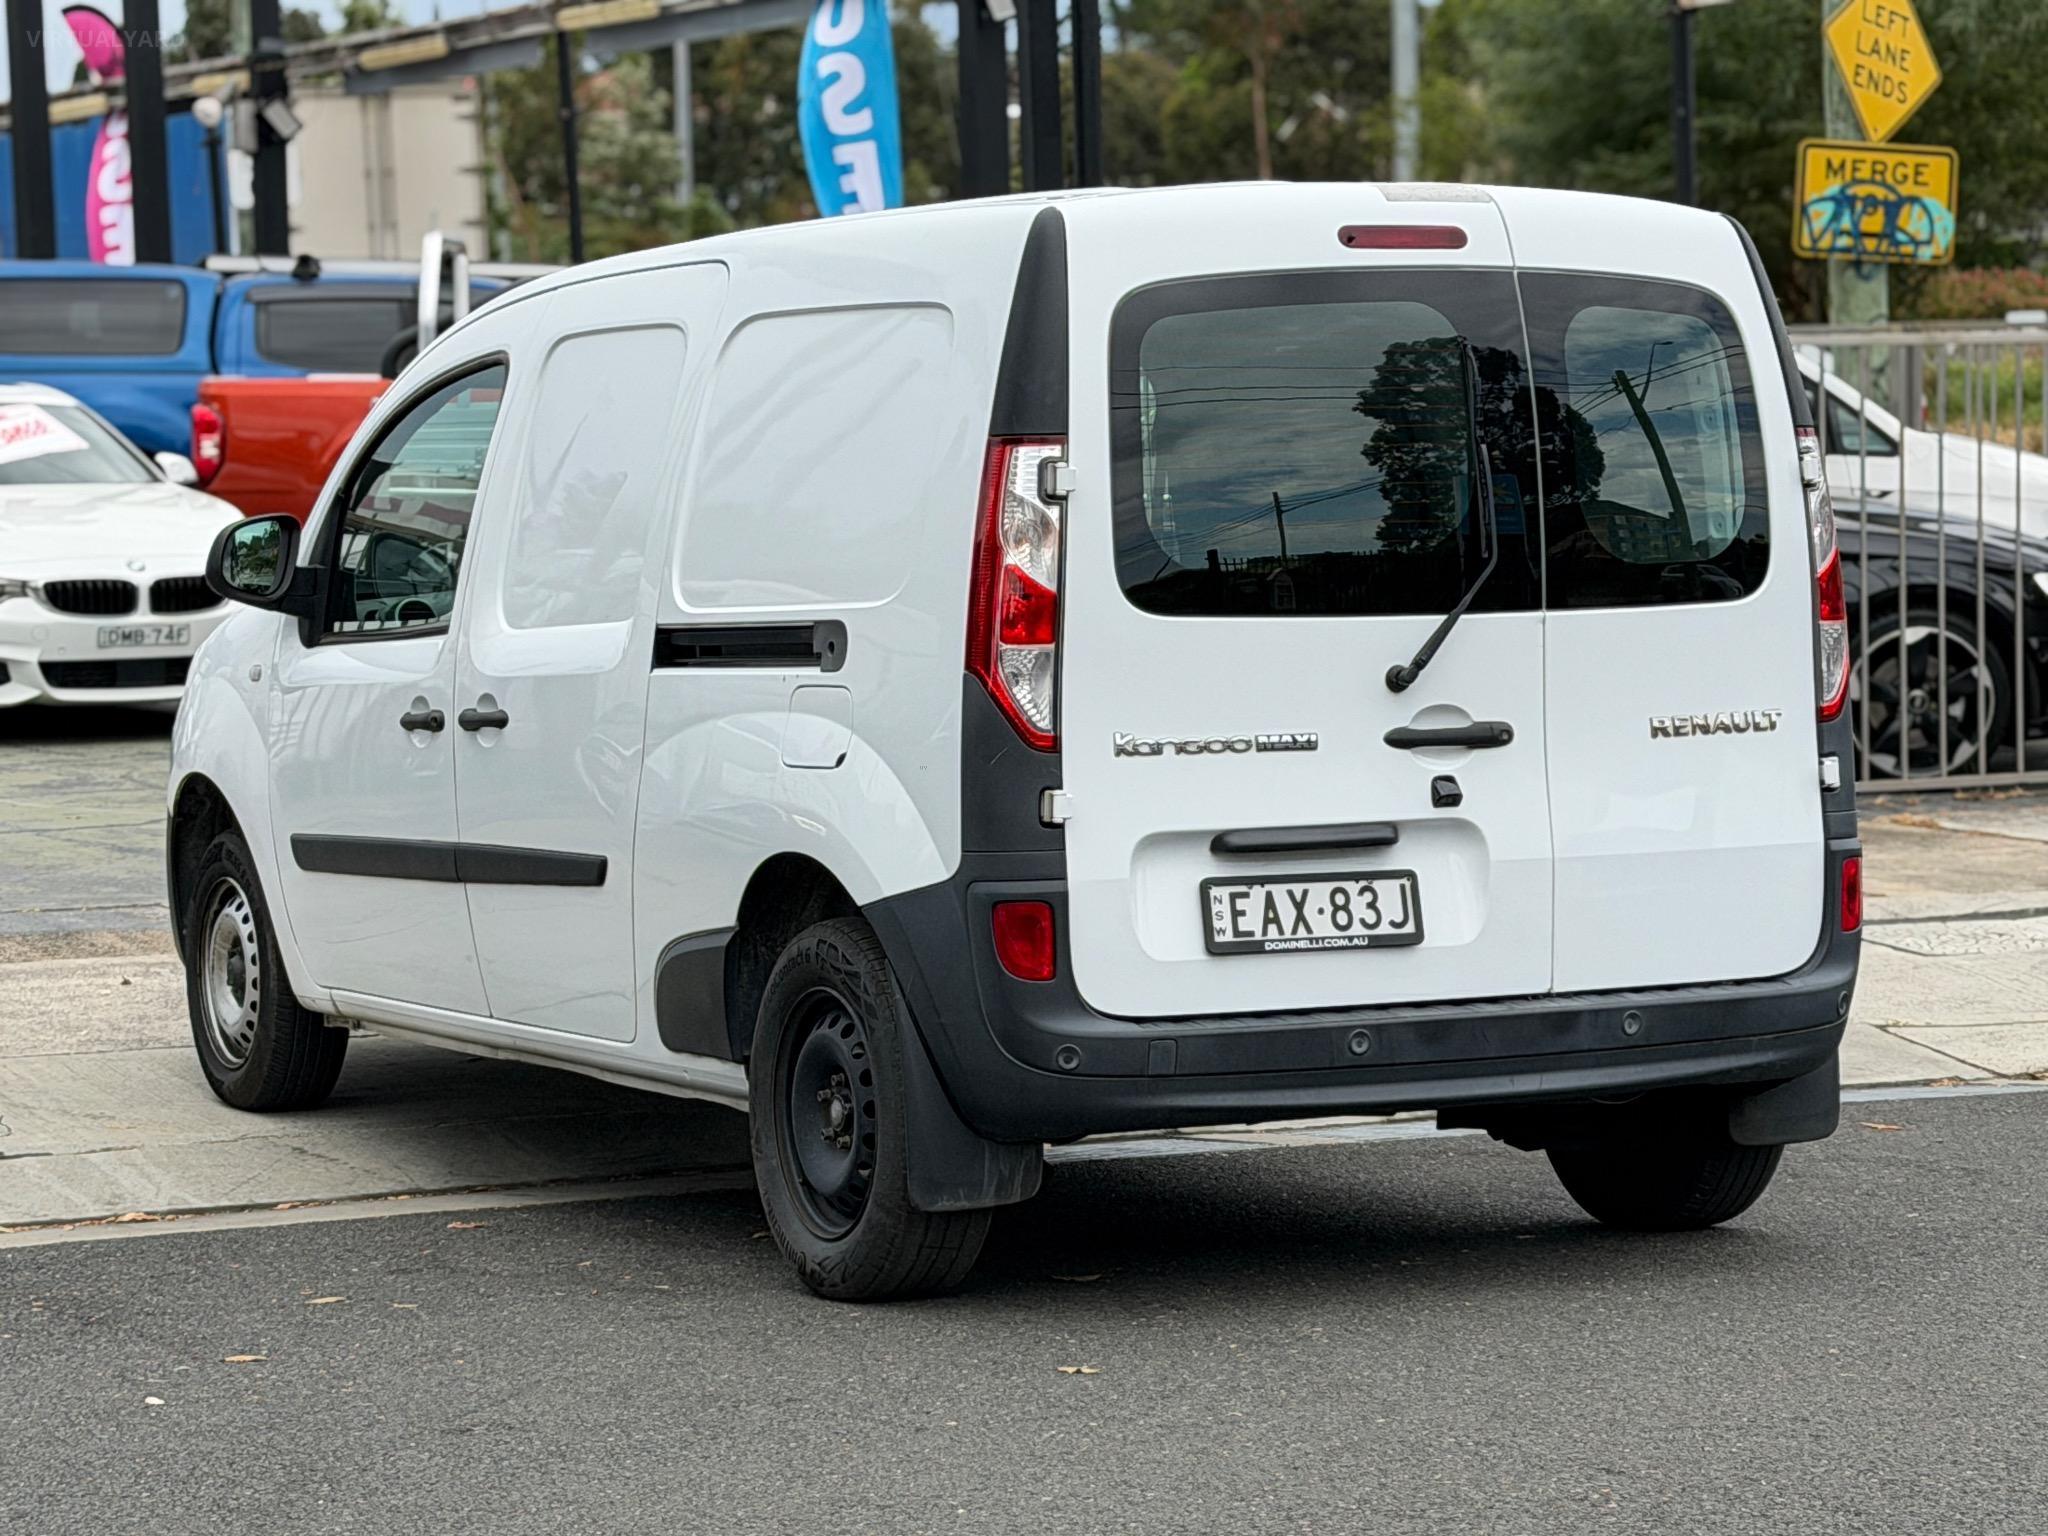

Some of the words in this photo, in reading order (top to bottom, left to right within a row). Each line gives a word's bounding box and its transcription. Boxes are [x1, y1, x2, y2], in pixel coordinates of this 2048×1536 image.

[1861, 0, 1910, 38] LEFT
[1856, 30, 1911, 73] LANE
[1853, 63, 1908, 104] ENDS
[1825, 156, 1931, 187] MERGE
[1650, 708, 1783, 739] RENAULT
[1256, 733, 1318, 752] MAXI
[1264, 936, 1369, 951] DOMINELLI.COM.AU
